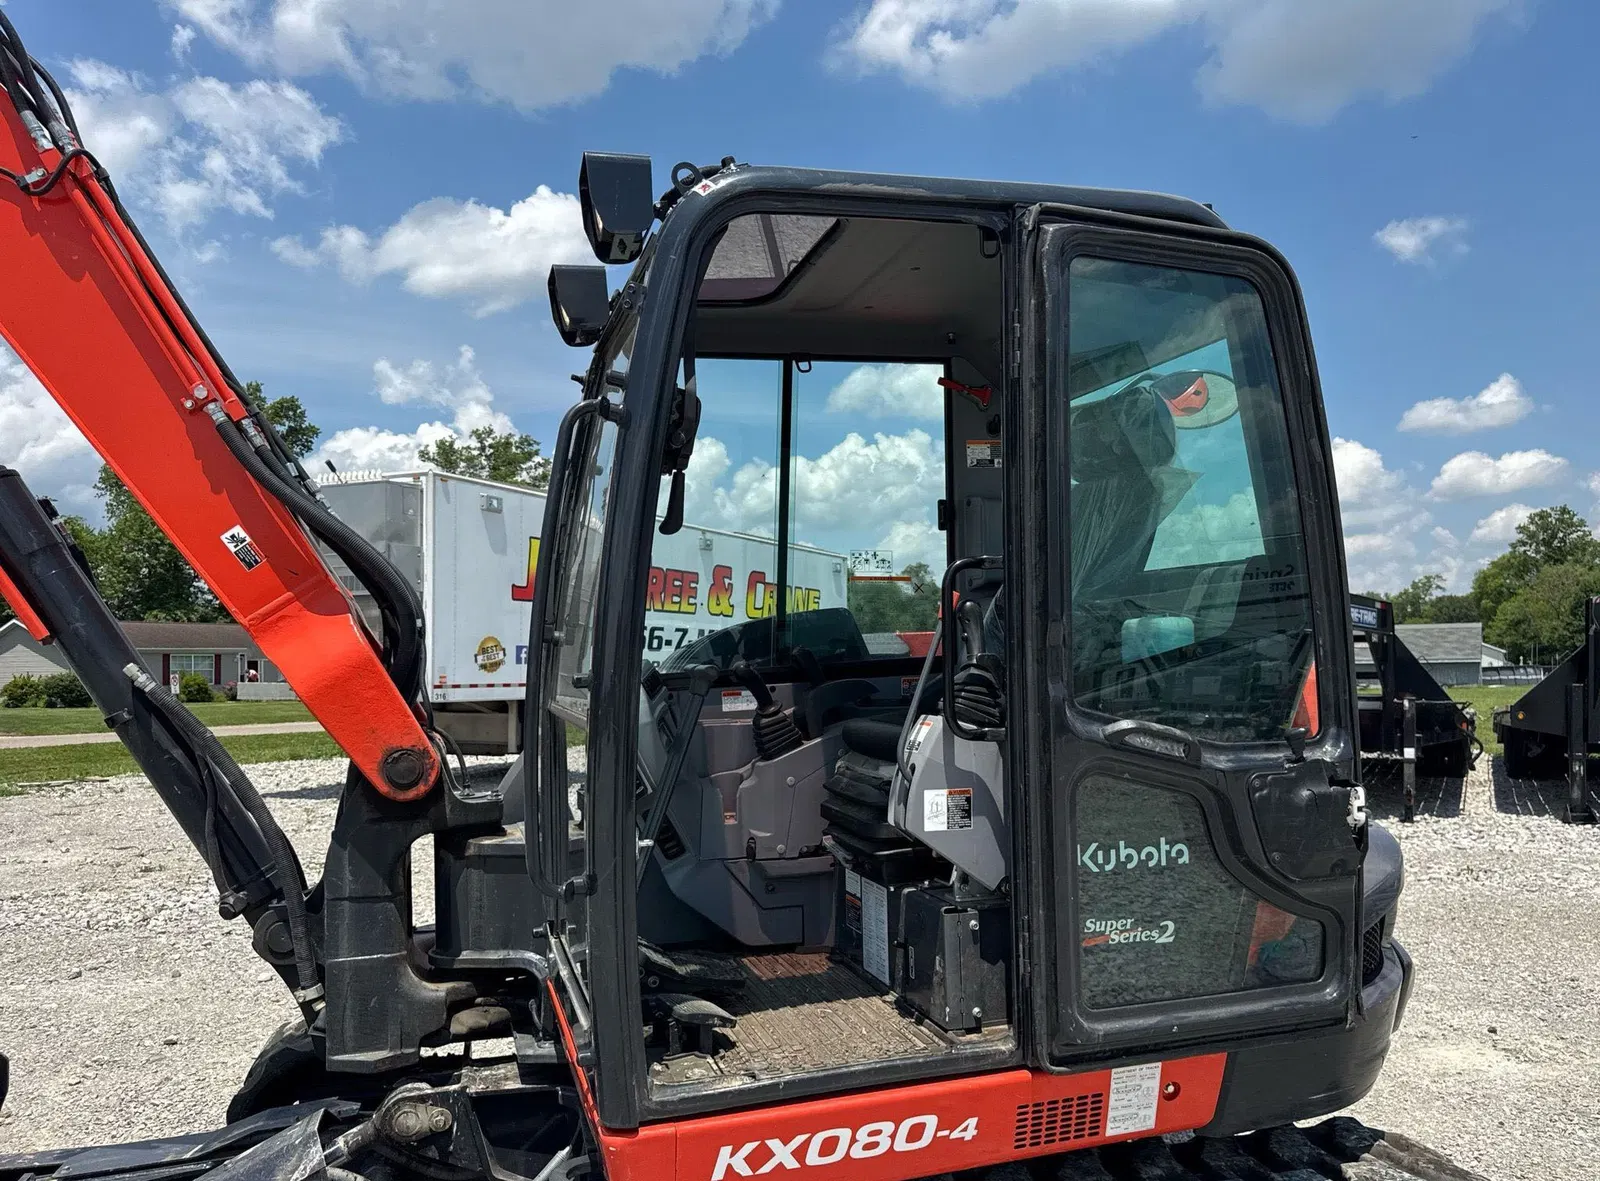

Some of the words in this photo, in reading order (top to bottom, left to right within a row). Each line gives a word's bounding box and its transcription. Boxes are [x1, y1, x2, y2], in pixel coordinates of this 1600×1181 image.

[646, 566, 699, 614] REE
[707, 564, 734, 617] &
[481, 644, 499, 655] BEST
[1077, 836, 1190, 873] Kubota
[1084, 916, 1134, 933] Super
[710, 1114, 979, 1181] KX080-4
